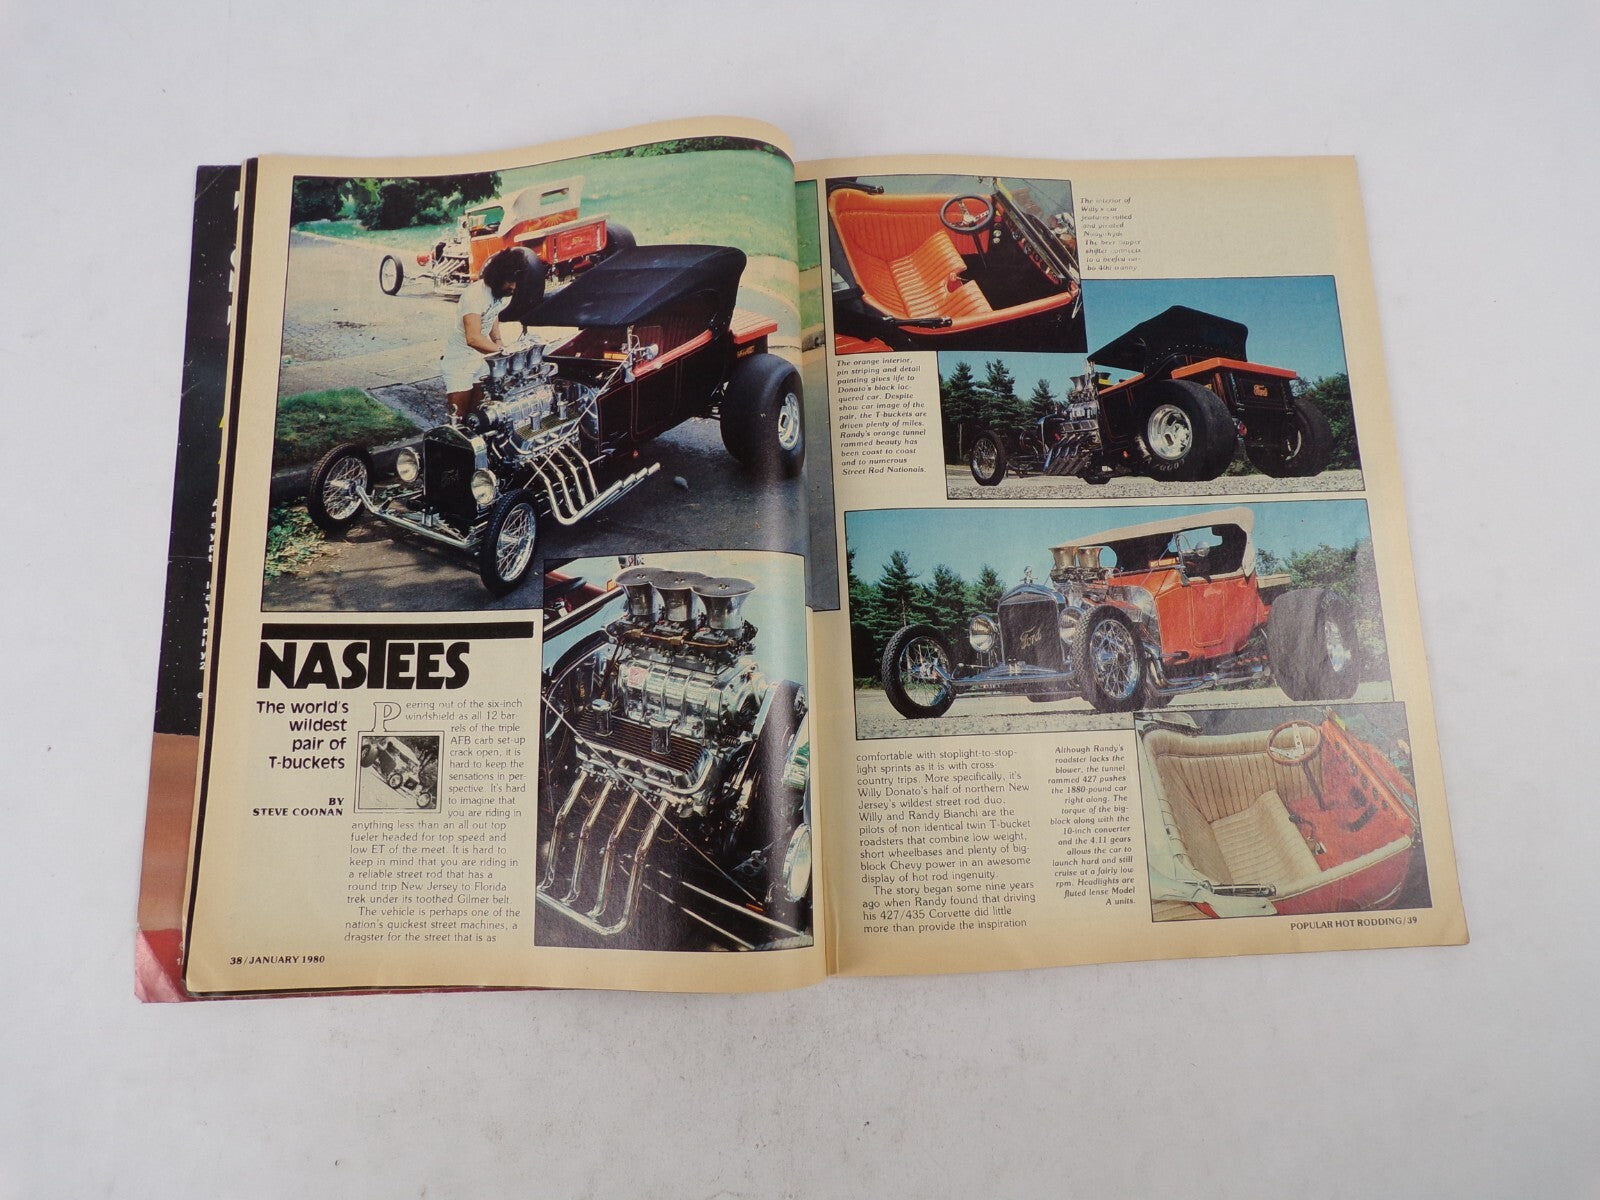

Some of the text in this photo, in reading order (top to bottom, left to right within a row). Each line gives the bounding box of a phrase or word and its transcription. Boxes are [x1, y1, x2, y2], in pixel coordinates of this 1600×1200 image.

[866, 421, 889, 430] plenty
[891, 420, 899, 428] of
[840, 431, 870, 439] Randy's
[257, 623, 470, 689] NASTEES
[257, 699, 348, 713] The world's
[457, 698, 466, 708] of
[469, 698, 483, 708] the
[487, 698, 522, 708] six-inch
[289, 717, 346, 731] wildest
[450, 722, 467, 732] rels
[468, 722, 480, 732] of
[481, 722, 495, 732] the
[292, 736, 346, 753] pair of
[450, 735, 471, 745] AFB
[474, 735, 493, 745] carb
[856, 751, 912, 761] comfortable
[916, 750, 935, 759] with
[1054, 744, 1123, 755] Although Randy's
[269, 755, 344, 769] T-buckets
[449, 758, 524, 770] hard to keep the
[857, 776, 893, 786] country
[925, 774, 949, 782] More
[1009, 770, 1021, 780] it's
[1048, 776, 1079, 784] rammed
[1099, 774, 1126, 784] pushes
[858, 782, 1029, 799] Willy Donato's half of northern New
[328, 797, 344, 805] BY
[1064, 796, 1083, 806] right
[1113, 794, 1127, 802] The
[252, 807, 342, 816] STEVE COONAN
[859, 807, 1014, 823] Willy and Randy Bianchi are the
[351, 820, 393, 832] anything
[418, 820, 438, 829] than
[458, 820, 468, 829] all
[491, 821, 506, 832] top
[859, 825, 884, 837] pilots
[888, 824, 897, 833] of
[924, 821, 963, 832] identical
[966, 821, 986, 830] twin
[1063, 826, 1091, 835] 10-inch
[350, 832, 506, 844] fueler headed for top speed and
[1110, 836, 1131, 845] gears
[860, 861, 886, 871] block
[890, 860, 921, 871] Chevy
[925, 860, 955, 871] power
[959, 859, 967, 867] in
[987, 857, 1030, 866] awesome
[1052, 855, 1132, 866] launch hard and still
[358, 868, 392, 878] reliable
[396, 870, 422, 878] street
[426, 868, 442, 878] rod
[446, 869, 463, 878] that
[468, 869, 484, 878] has
[347, 893, 365, 903] trek
[369, 894, 398, 903] under
[402, 895, 412, 903] its
[416, 894, 453, 904] toothed
[457, 894, 489, 904] Gilmer
[862, 893, 1035, 911] ago when Randy found that driving
[360, 906, 376, 916] The
[381, 906, 414, 916] vehicle
[418, 908, 425, 916] is
[429, 906, 467, 918] perhaps
[492, 907, 501, 917] of
[505, 907, 520, 917] the
[863, 906, 1011, 921] his 427/435 Corvette did little
[892, 923, 914, 932] than
[918, 921, 955, 934] provide
[959, 920, 974, 929] the
[978, 919, 1026, 930] inspiration
[1290, 920, 1332, 930] POPULAR
[1335, 919, 1354, 928] HOT
[302, 955, 324, 963] 1980
